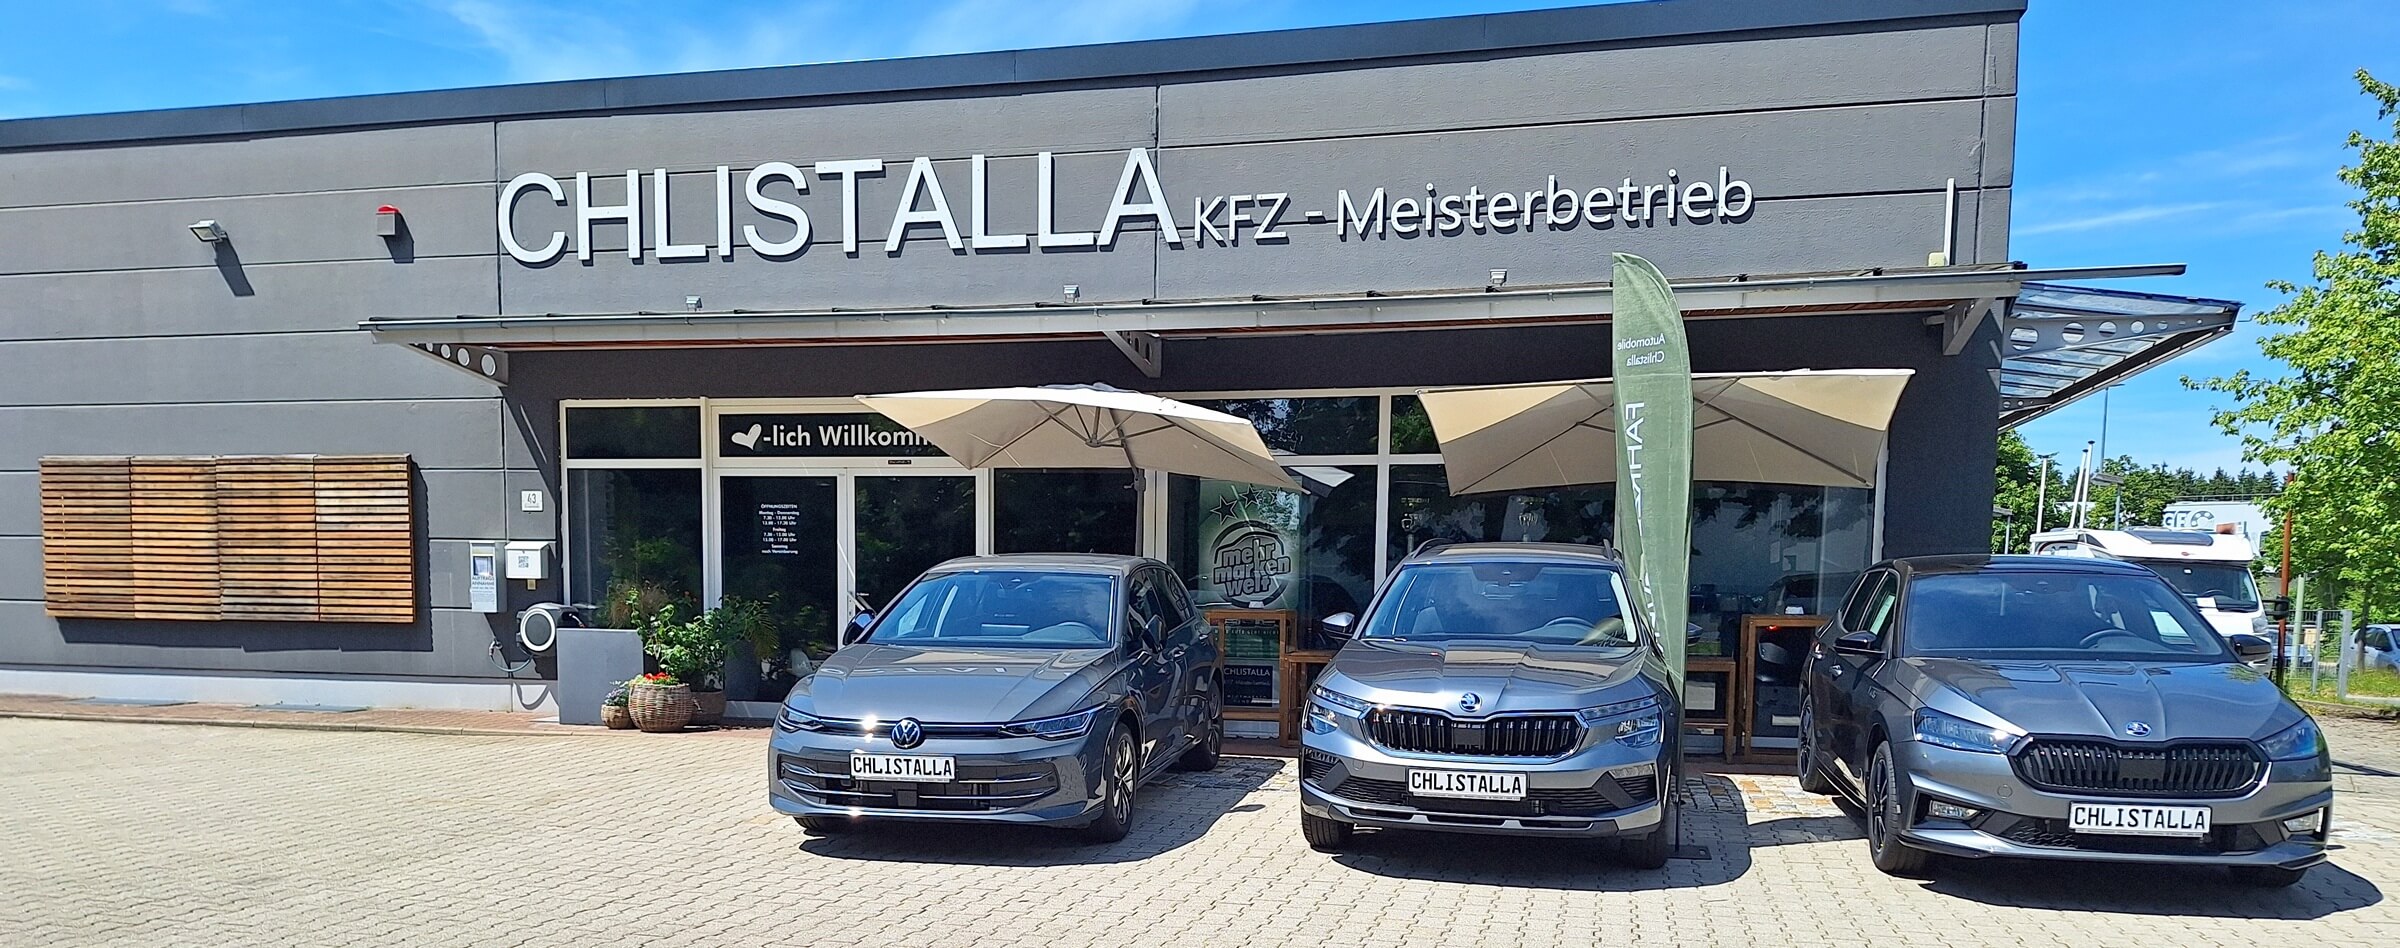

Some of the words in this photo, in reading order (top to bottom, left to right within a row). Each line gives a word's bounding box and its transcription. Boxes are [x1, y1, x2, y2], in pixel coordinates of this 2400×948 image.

[498, 147, 1182, 263] CHLISTALLA
[1194, 192, 1288, 242] KFZ
[1337, 166, 1753, 236] Meisterbetrieb
[527, 493, 537, 504] 43
[1222, 538, 1276, 568] mehr
[1213, 556, 1291, 585] marken
[1225, 574, 1272, 597] welt
[1224, 667, 1270, 677] CHLISTALLA
[853, 756, 952, 776] CHLISTALLA
[1411, 772, 1522, 794] CHLISTALLA
[2074, 806, 2205, 830] CHLISTALLA
